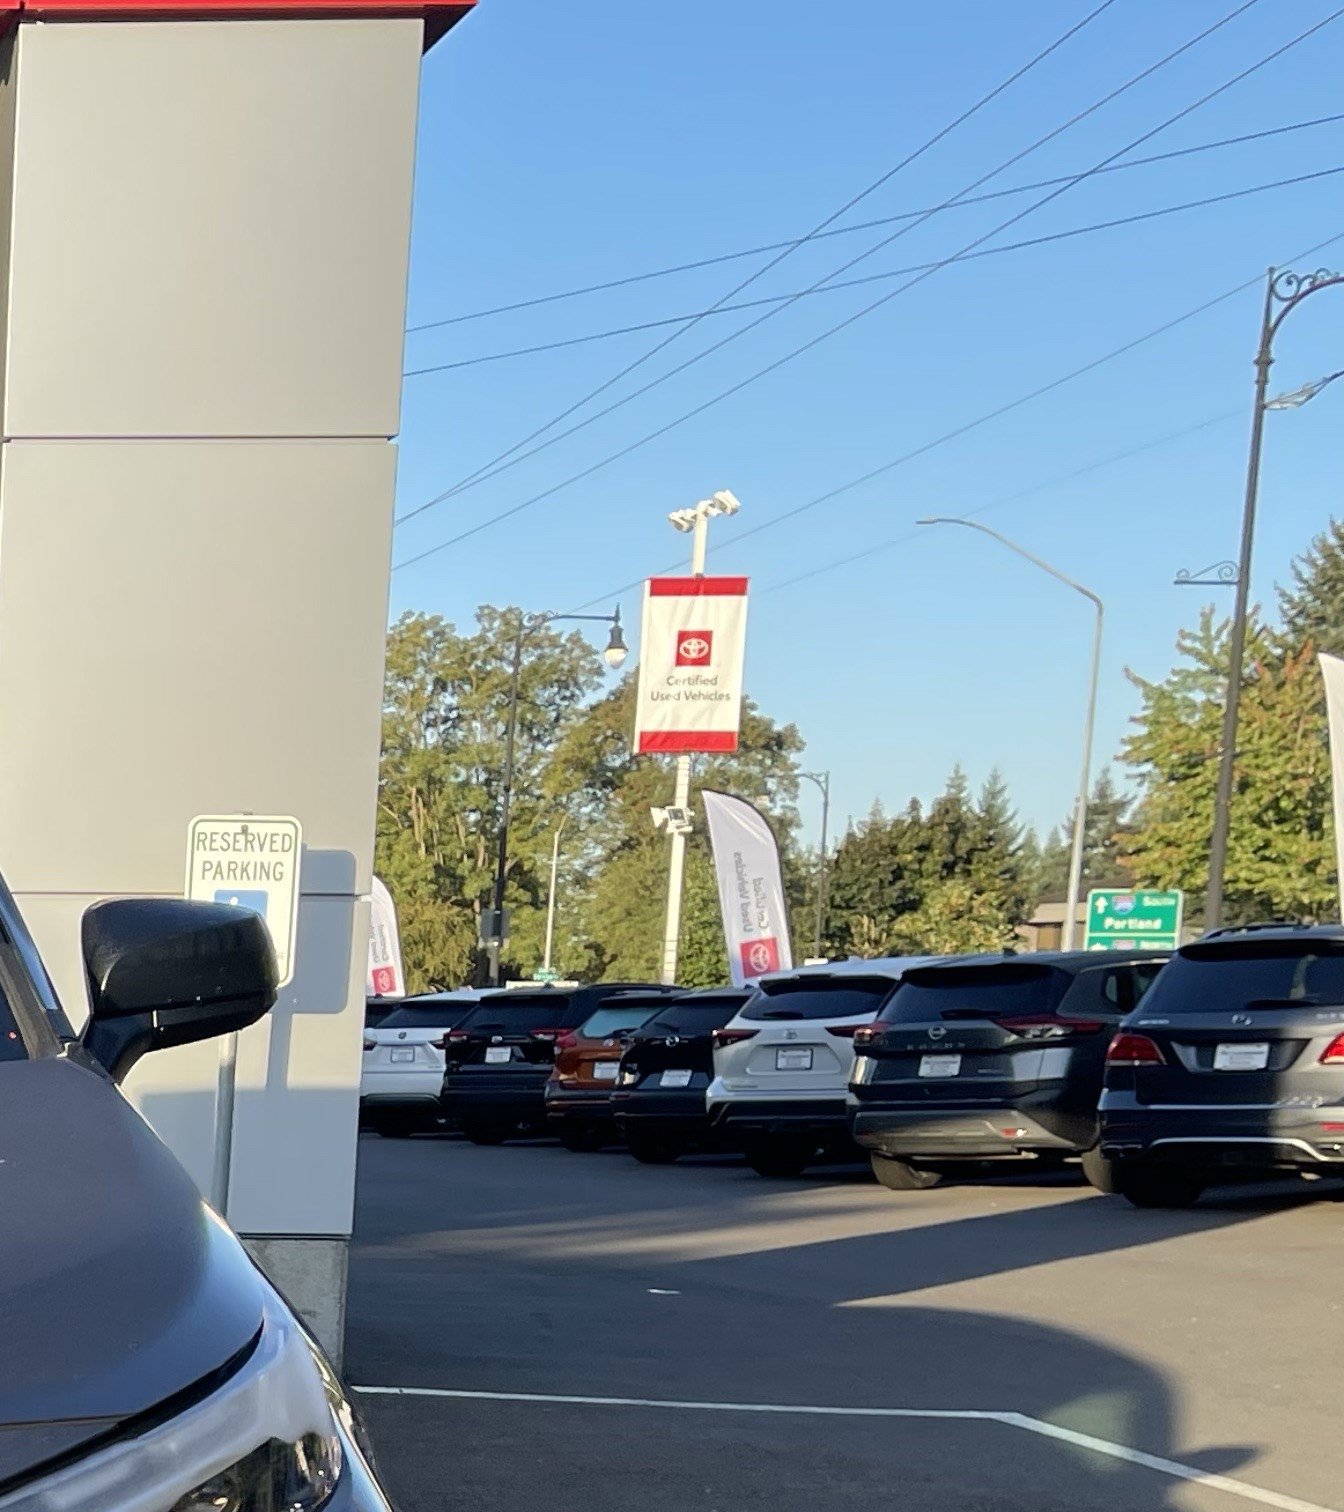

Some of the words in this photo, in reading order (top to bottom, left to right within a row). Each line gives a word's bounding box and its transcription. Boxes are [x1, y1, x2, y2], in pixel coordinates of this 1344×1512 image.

[666, 674, 718, 686] Certified
[651, 691, 681, 701] Used
[683, 690, 731, 701] Vehicles
[196, 831, 293, 853] RESERVED
[201, 861, 285, 882] PARKING
[1104, 917, 1162, 929] Portland
